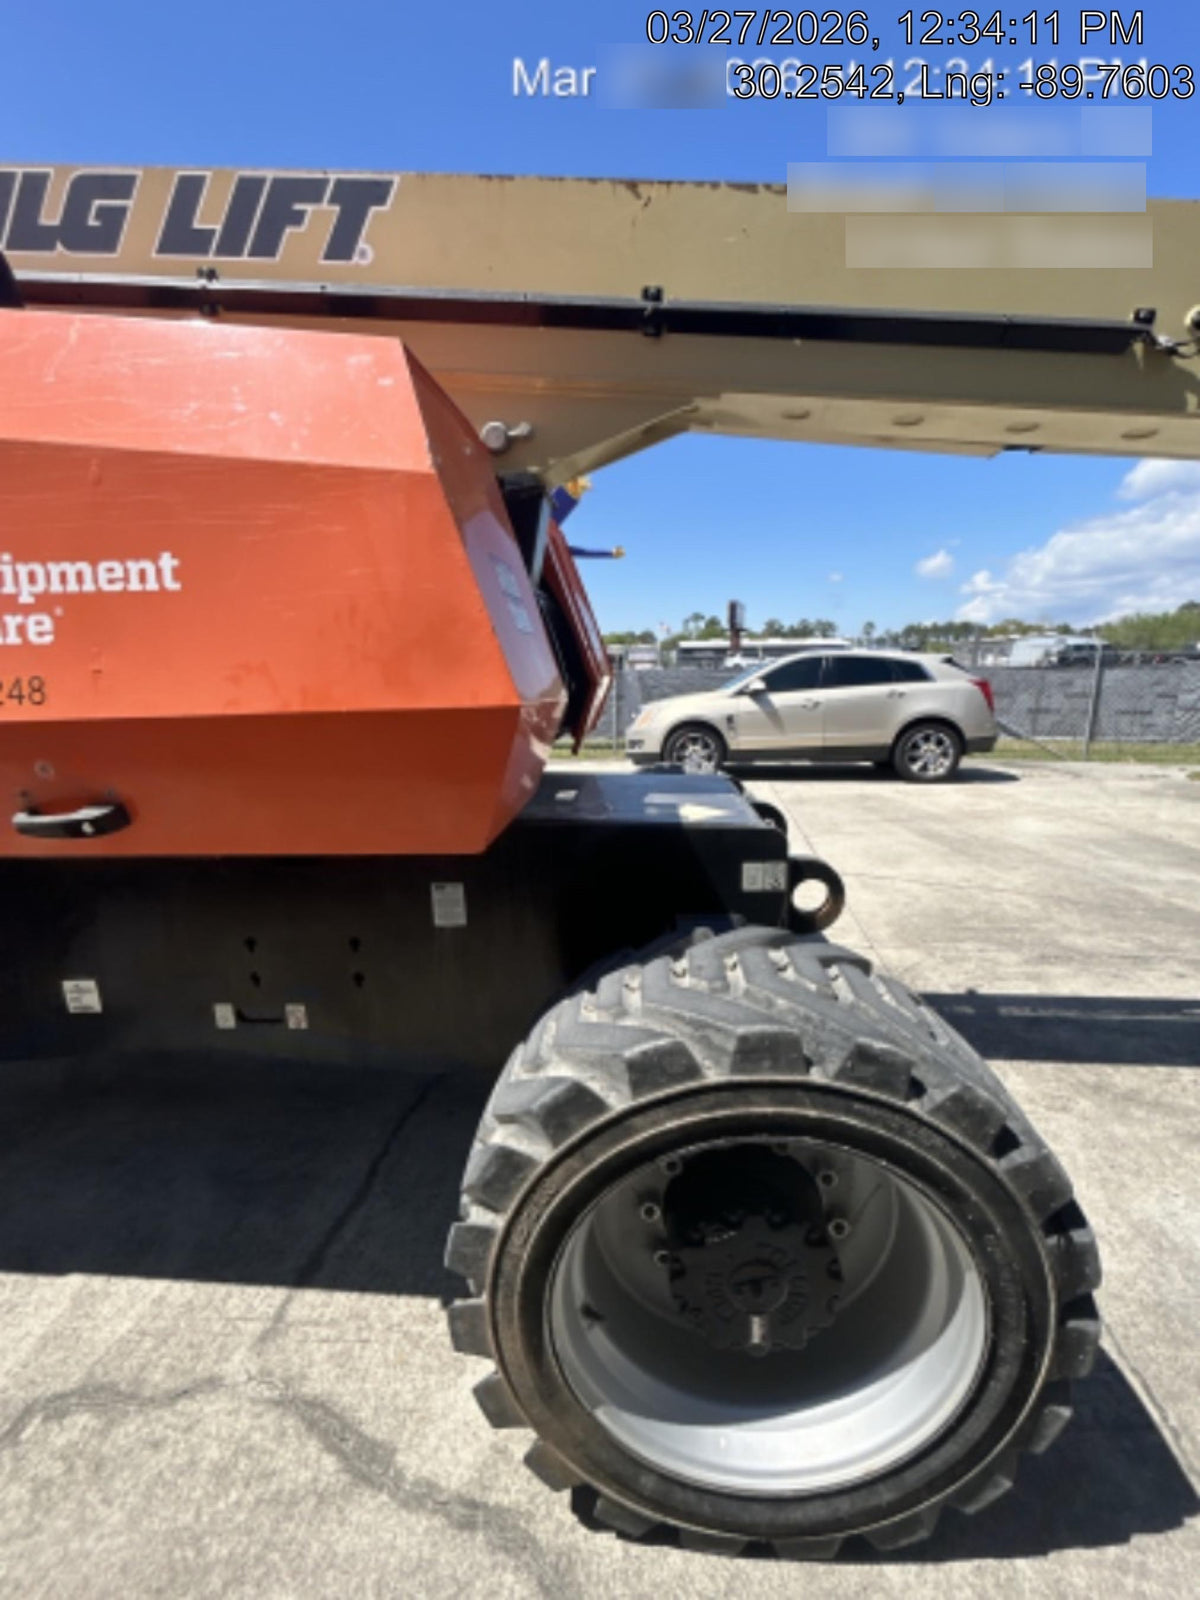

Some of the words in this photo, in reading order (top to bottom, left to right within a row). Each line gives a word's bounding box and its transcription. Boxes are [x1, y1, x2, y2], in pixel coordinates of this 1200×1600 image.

[152, 171, 400, 265] LIFT
[0, 612, 55, 645] re
[0, 675, 46, 706] 48
